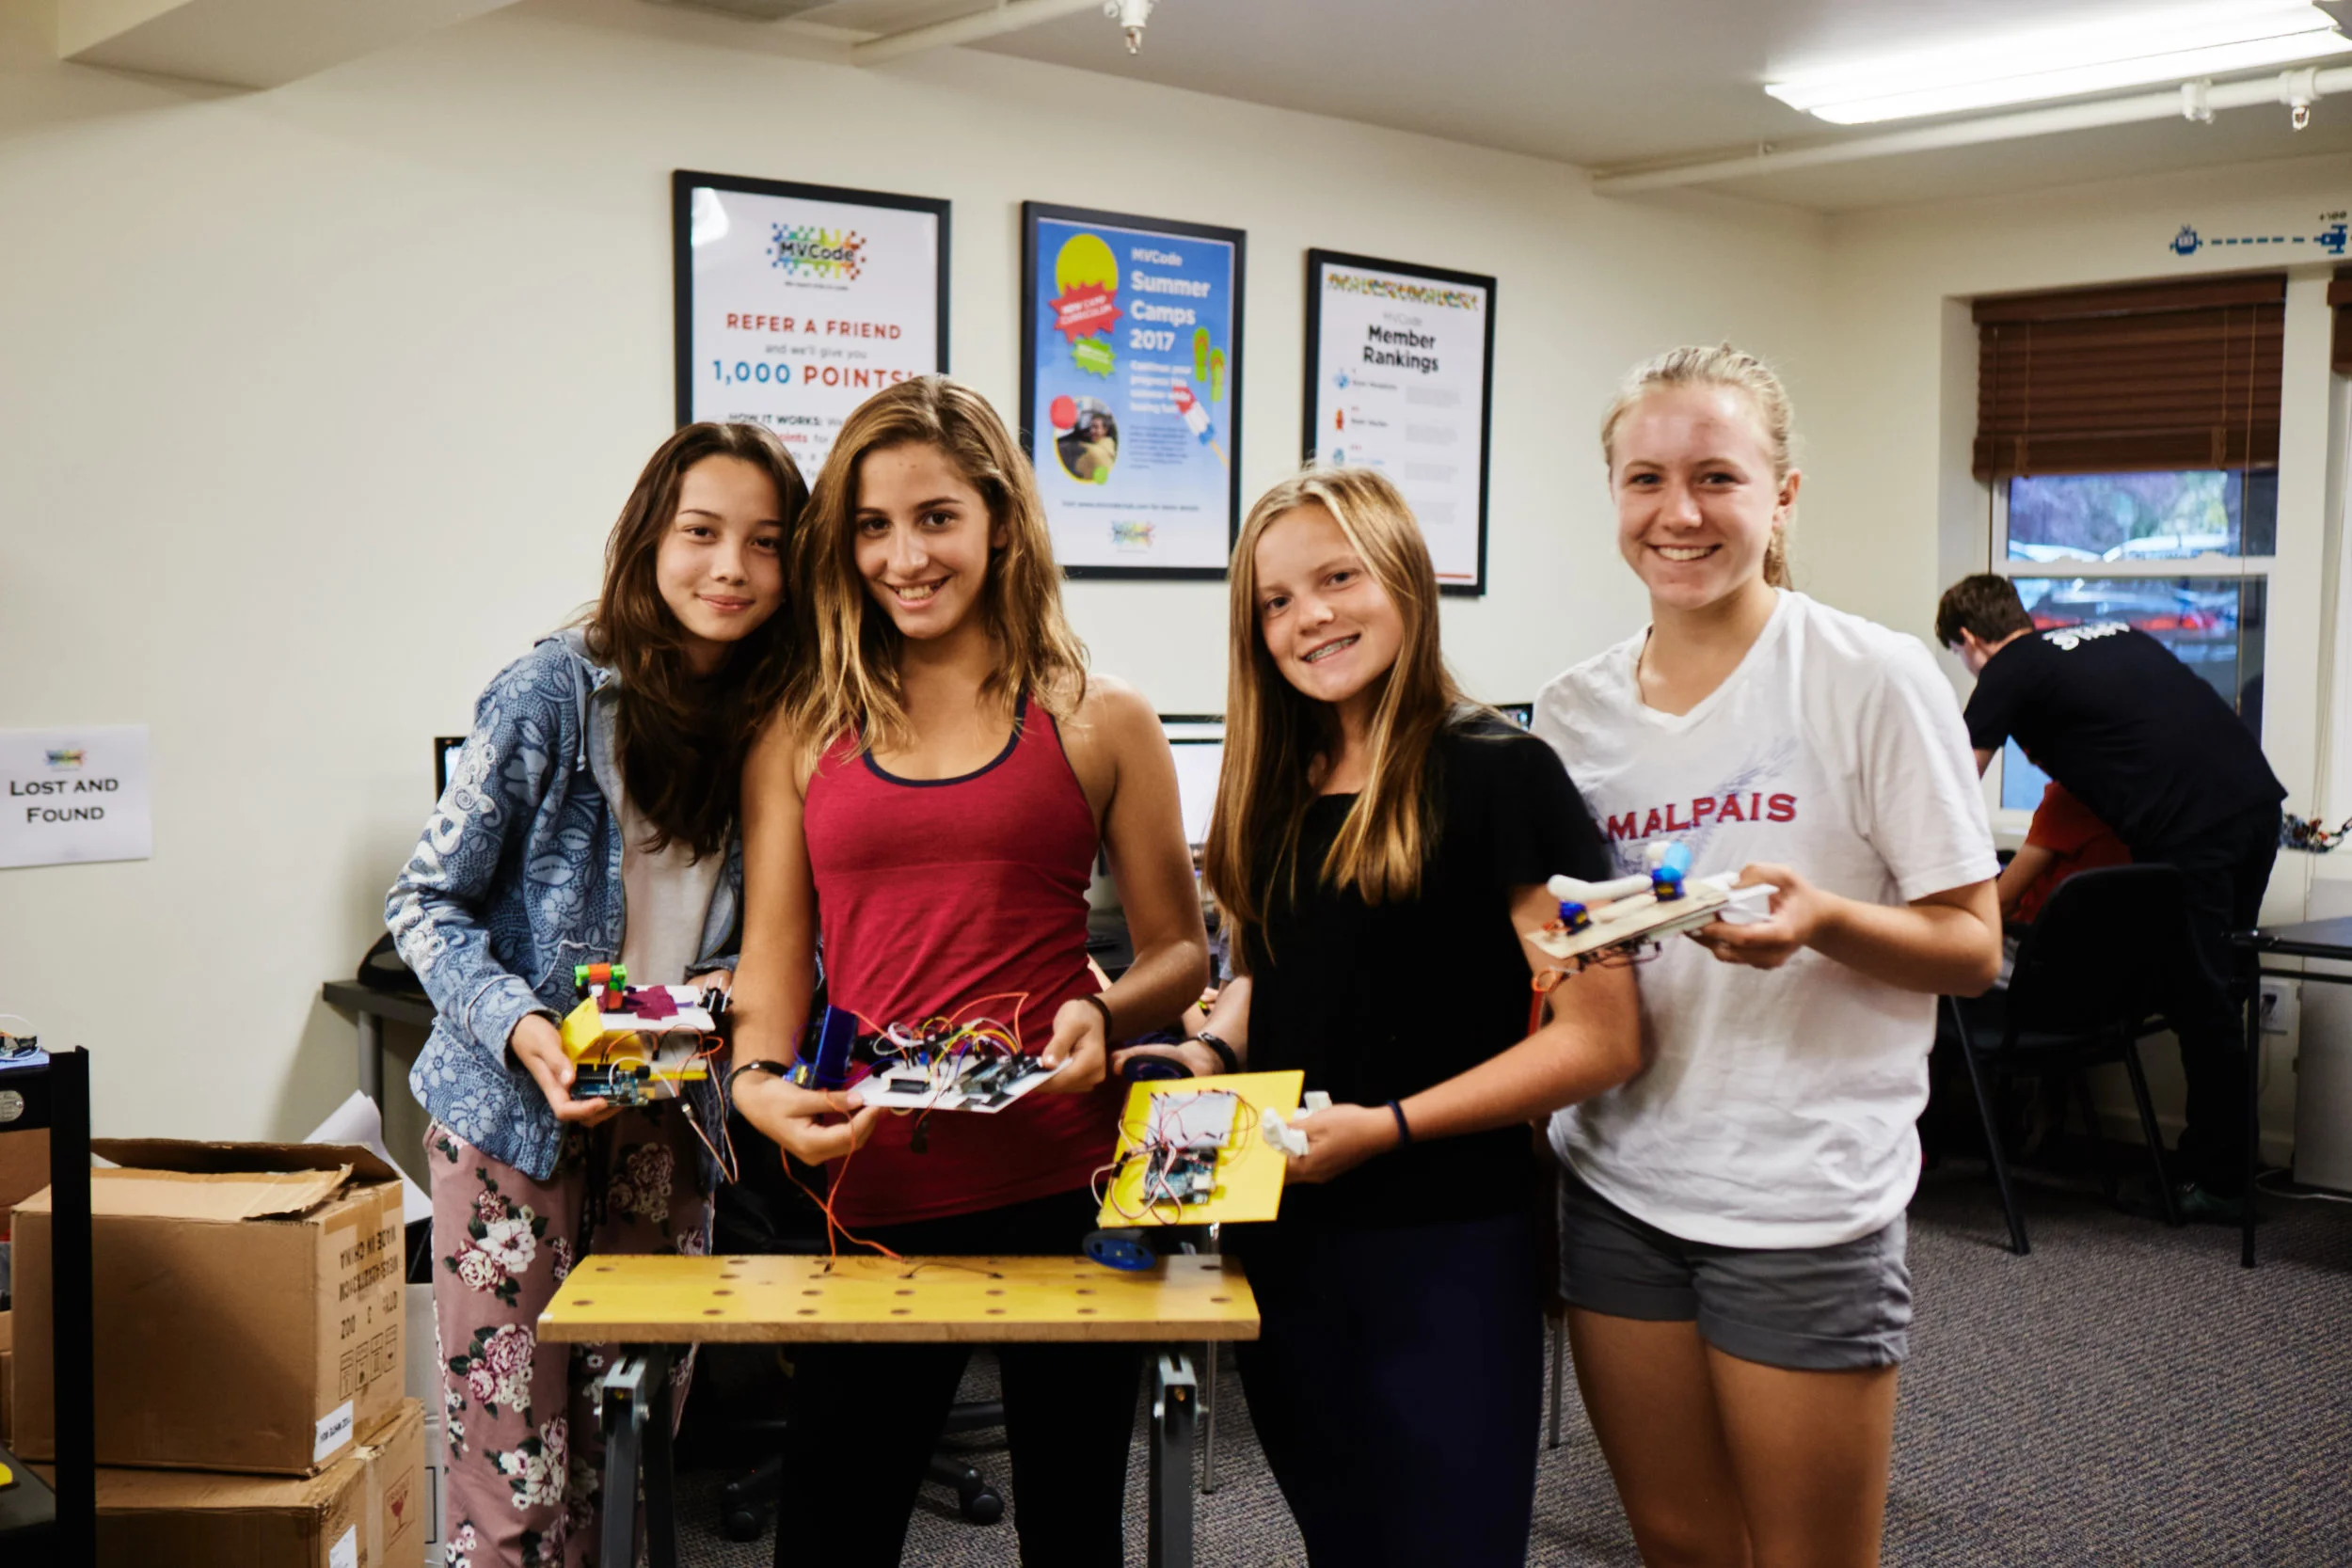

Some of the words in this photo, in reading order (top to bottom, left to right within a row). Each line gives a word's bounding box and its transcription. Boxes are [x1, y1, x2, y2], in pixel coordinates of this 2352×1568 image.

[780, 241, 854, 261] MVCode
[1132, 247, 1183, 267] MVCode
[1131, 270, 1211, 298] Summer
[1131, 300, 1196, 327] Camps
[726, 313, 795, 332] REFER
[804, 320, 818, 335] A
[827, 320, 901, 340] FRIEND
[1368, 325, 1437, 349] Member
[765, 344, 787, 355] and
[820, 348, 843, 359] give
[848, 350, 867, 360] you
[1130, 328, 1175, 352] 2017
[1363, 345, 1439, 373] Rankings
[712, 360, 790, 386] 1,000
[762, 414, 772, 422] IT
[776, 431, 807, 443] oints
[9, 780, 67, 797] LOST
[73, 778, 119, 793] AND
[26, 807, 104, 823] FOUND
[1599, 792, 1797, 840] MALPAIS
